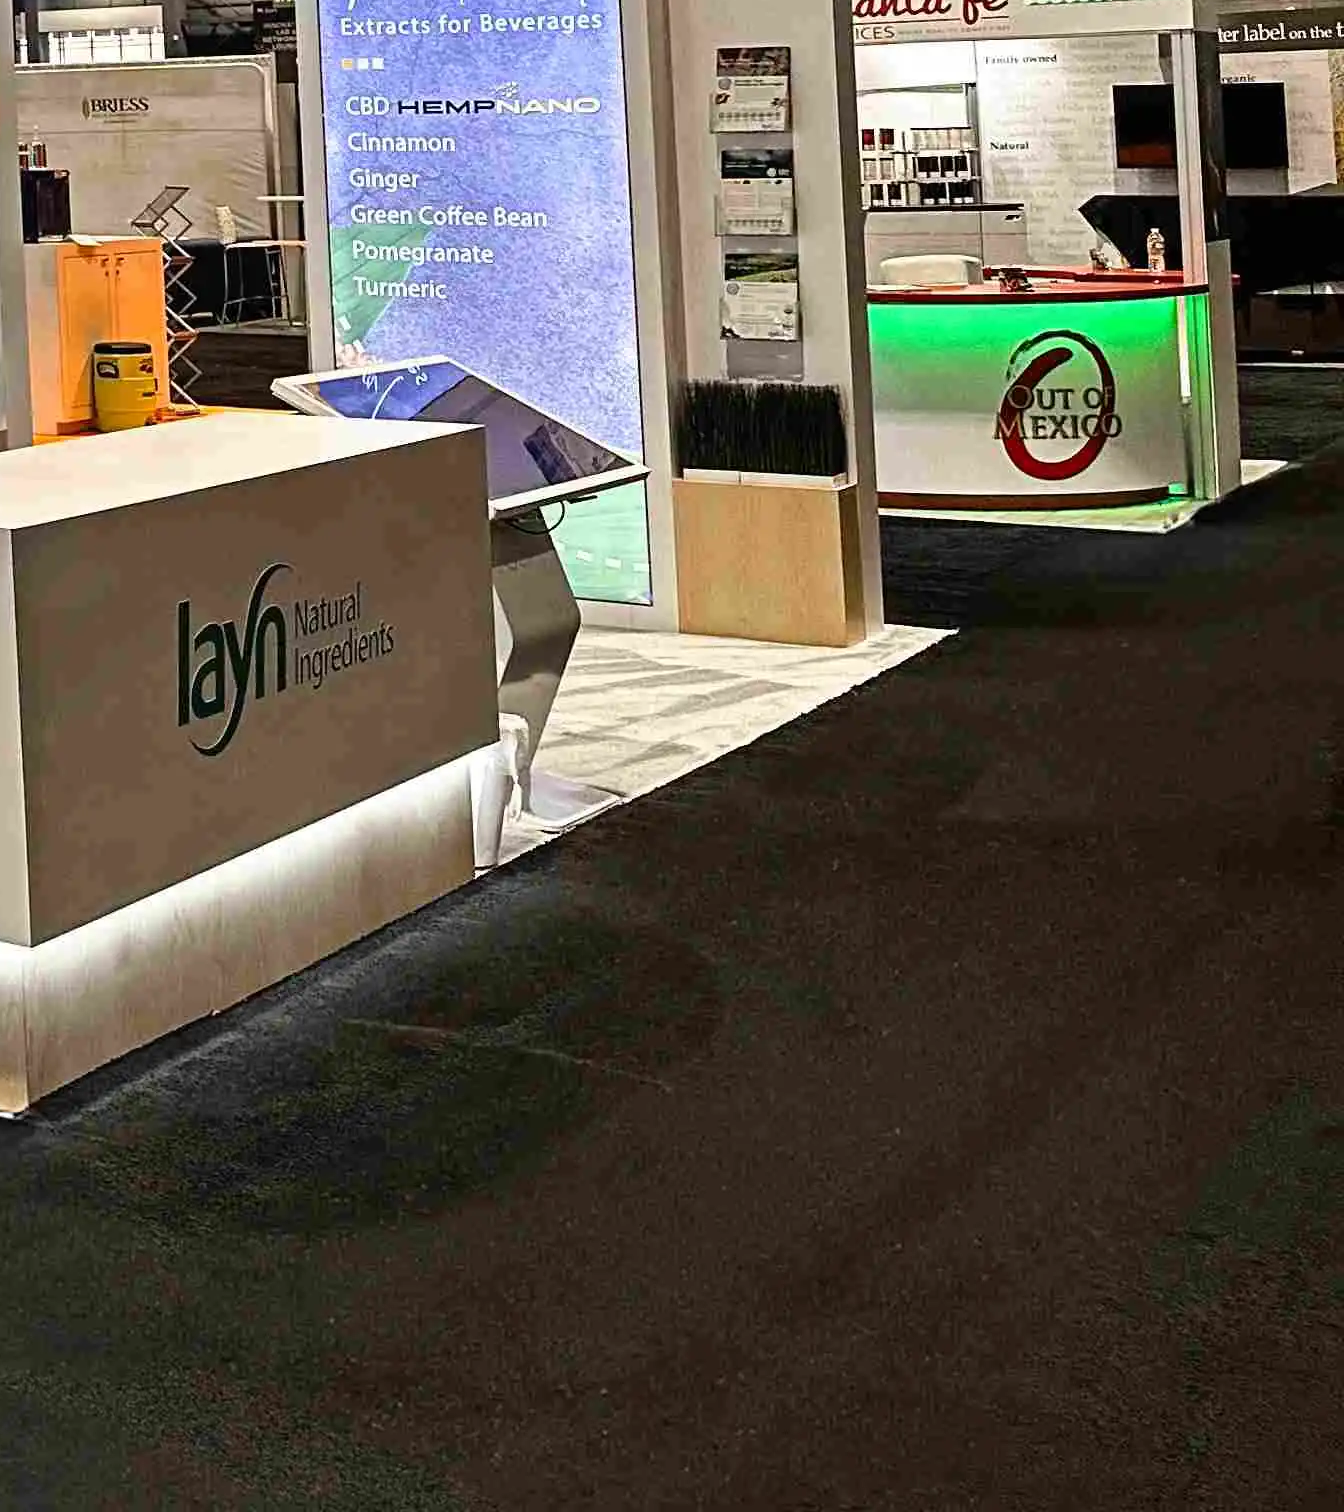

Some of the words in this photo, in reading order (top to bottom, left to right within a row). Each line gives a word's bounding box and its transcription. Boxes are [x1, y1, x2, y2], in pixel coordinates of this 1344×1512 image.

[340, 15, 430, 36] Extracts
[438, 14, 472, 34] for
[479, 11, 602, 37] Beverages
[1243, 22, 1286, 41] label
[1289, 29, 1307, 40] on
[1310, 25, 1333, 39] the
[1023, 54, 1057, 63] owned
[91, 97, 149, 112] BRIESS
[345, 96, 390, 116] CBD
[347, 132, 456, 153] Cinnamon
[990, 141, 1029, 150] Natural
[349, 168, 420, 193] Ginger
[351, 205, 413, 226] Green
[419, 205, 488, 228] Coffee
[494, 206, 548, 228] Bean
[352, 241, 494, 267] Pomegranate
[353, 276, 447, 300] Turmeric
[1007, 384, 1074, 410] OUT
[993, 411, 1123, 440] MEXICO
[178, 562, 294, 757] layn
[294, 581, 362, 639] Natural
[295, 620, 395, 690] Ingredients
